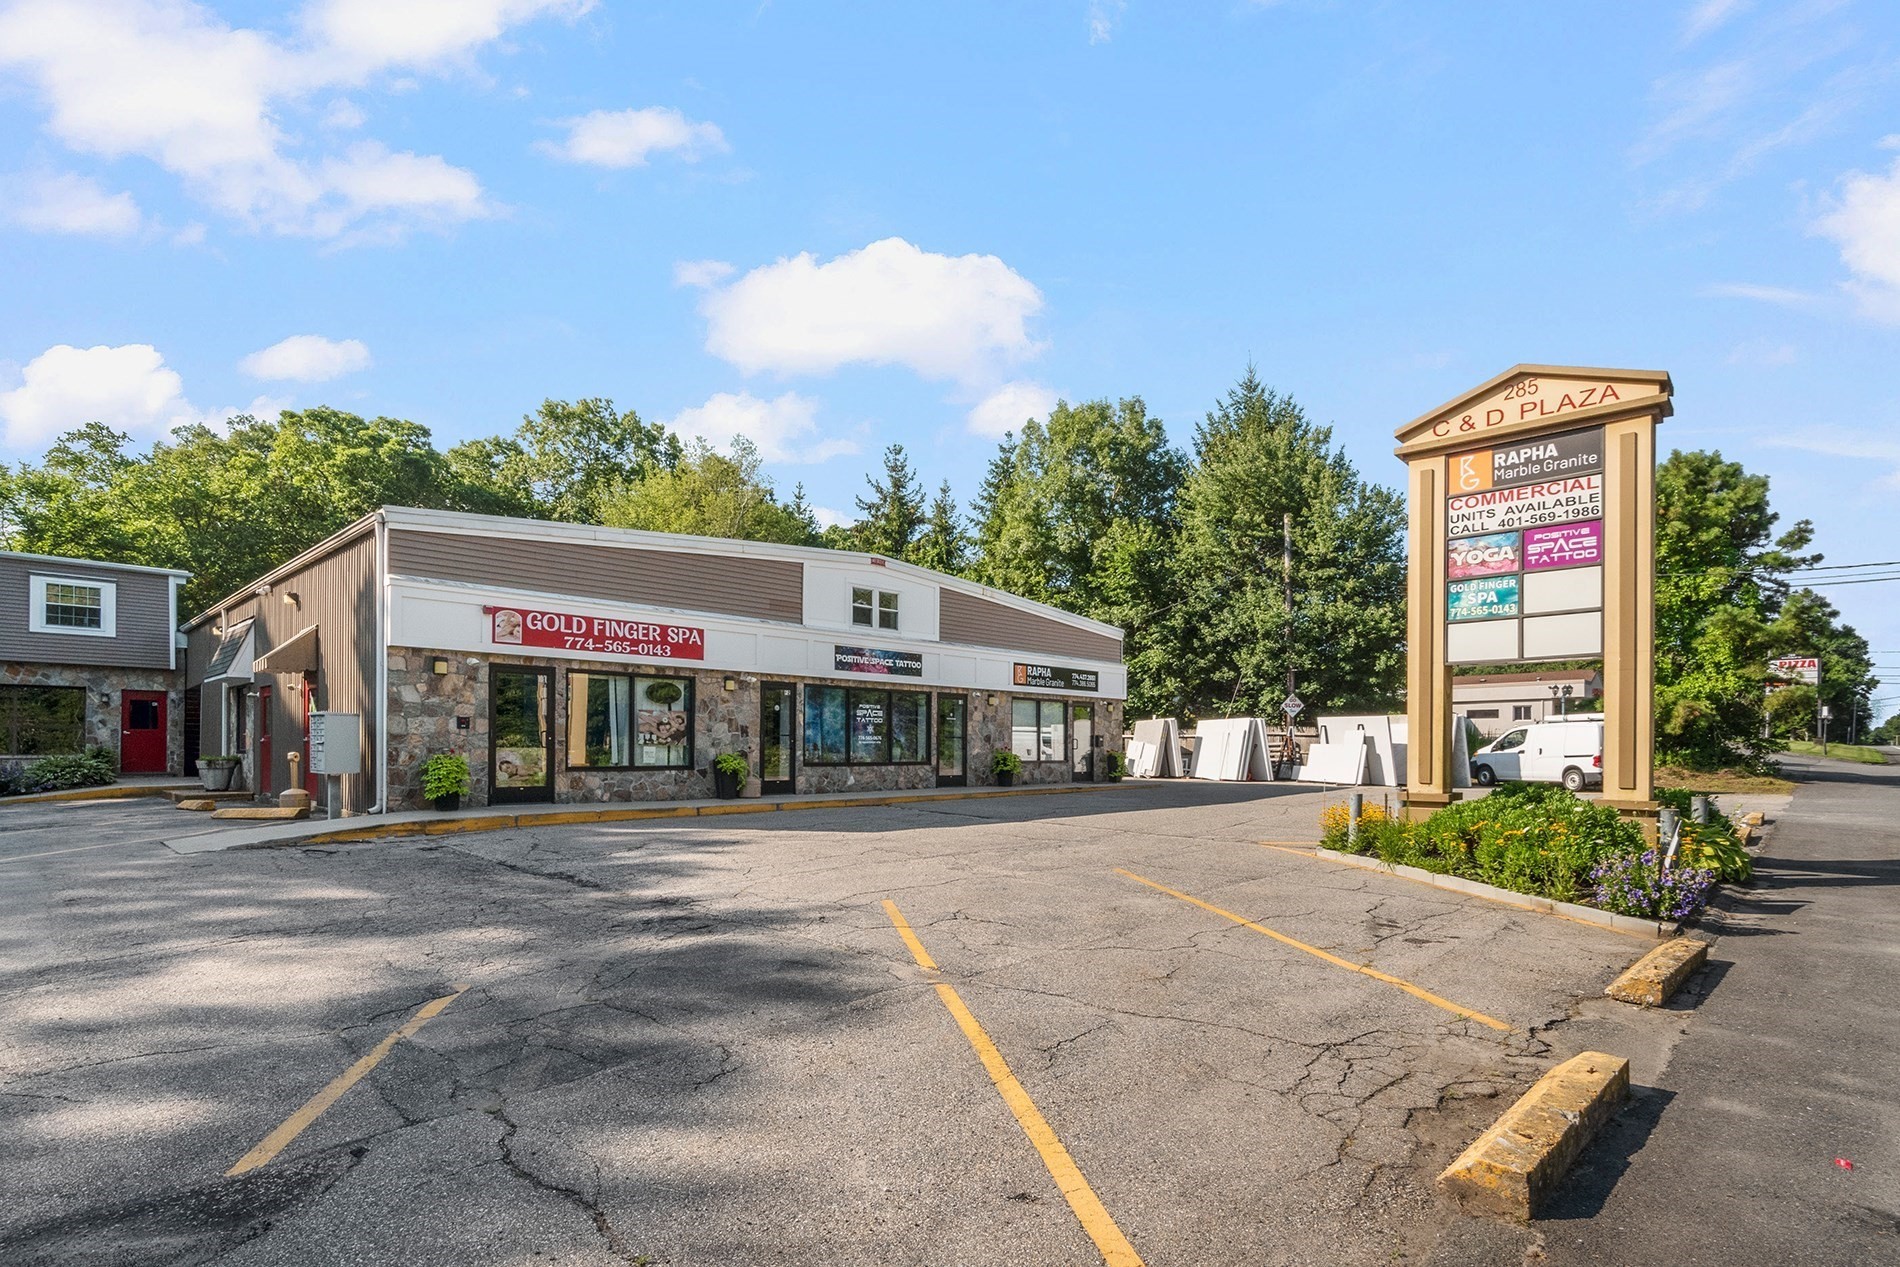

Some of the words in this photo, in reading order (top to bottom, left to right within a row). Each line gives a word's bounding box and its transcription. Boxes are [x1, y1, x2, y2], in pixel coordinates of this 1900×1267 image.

[1504, 378, 1539, 401] 285
[1432, 420, 1450, 437] C
[1459, 415, 1476, 432] &
[1486, 409, 1505, 427] D
[1520, 384, 1620, 420] PLAZA
[1494, 443, 1558, 467] RAPHA
[1494, 463, 1541, 481] Marble
[1543, 453, 1598, 473] Granite
[1450, 477, 1600, 511] COMMERCIAL
[1450, 508, 1496, 524] UNITS
[1504, 492, 1600, 516] AVAILABLE
[1450, 521, 1489, 536] CALL
[1498, 505, 1600, 529] 401-569-1986
[1534, 527, 1590, 541] POSITIVE
[1527, 536, 1597, 554] SPACE
[1450, 546, 1515, 567] YOGA
[1527, 548, 1597, 564] TATTOO
[1450, 583, 1477, 593] GOLD
[1479, 579, 1516, 590] FINGER
[1467, 591, 1498, 604] SPA
[1450, 603, 1516, 617] 774-565-0143
[526, 612, 587, 634] GOLD
[593, 619, 661, 641] FINGER
[667, 628, 702, 646] SPA
[564, 636, 671, 657] 774-565-0143
[835, 654, 868, 664] POSITIVE
[869, 658, 894, 666] SPACE
[895, 660, 922, 669] TATTOO
[1779, 660, 1816, 668] PIZZA
[1027, 666, 1052, 677] RAPHA
[1027, 676, 1046, 686] Marble
[1046, 678, 1065, 687] Granite
